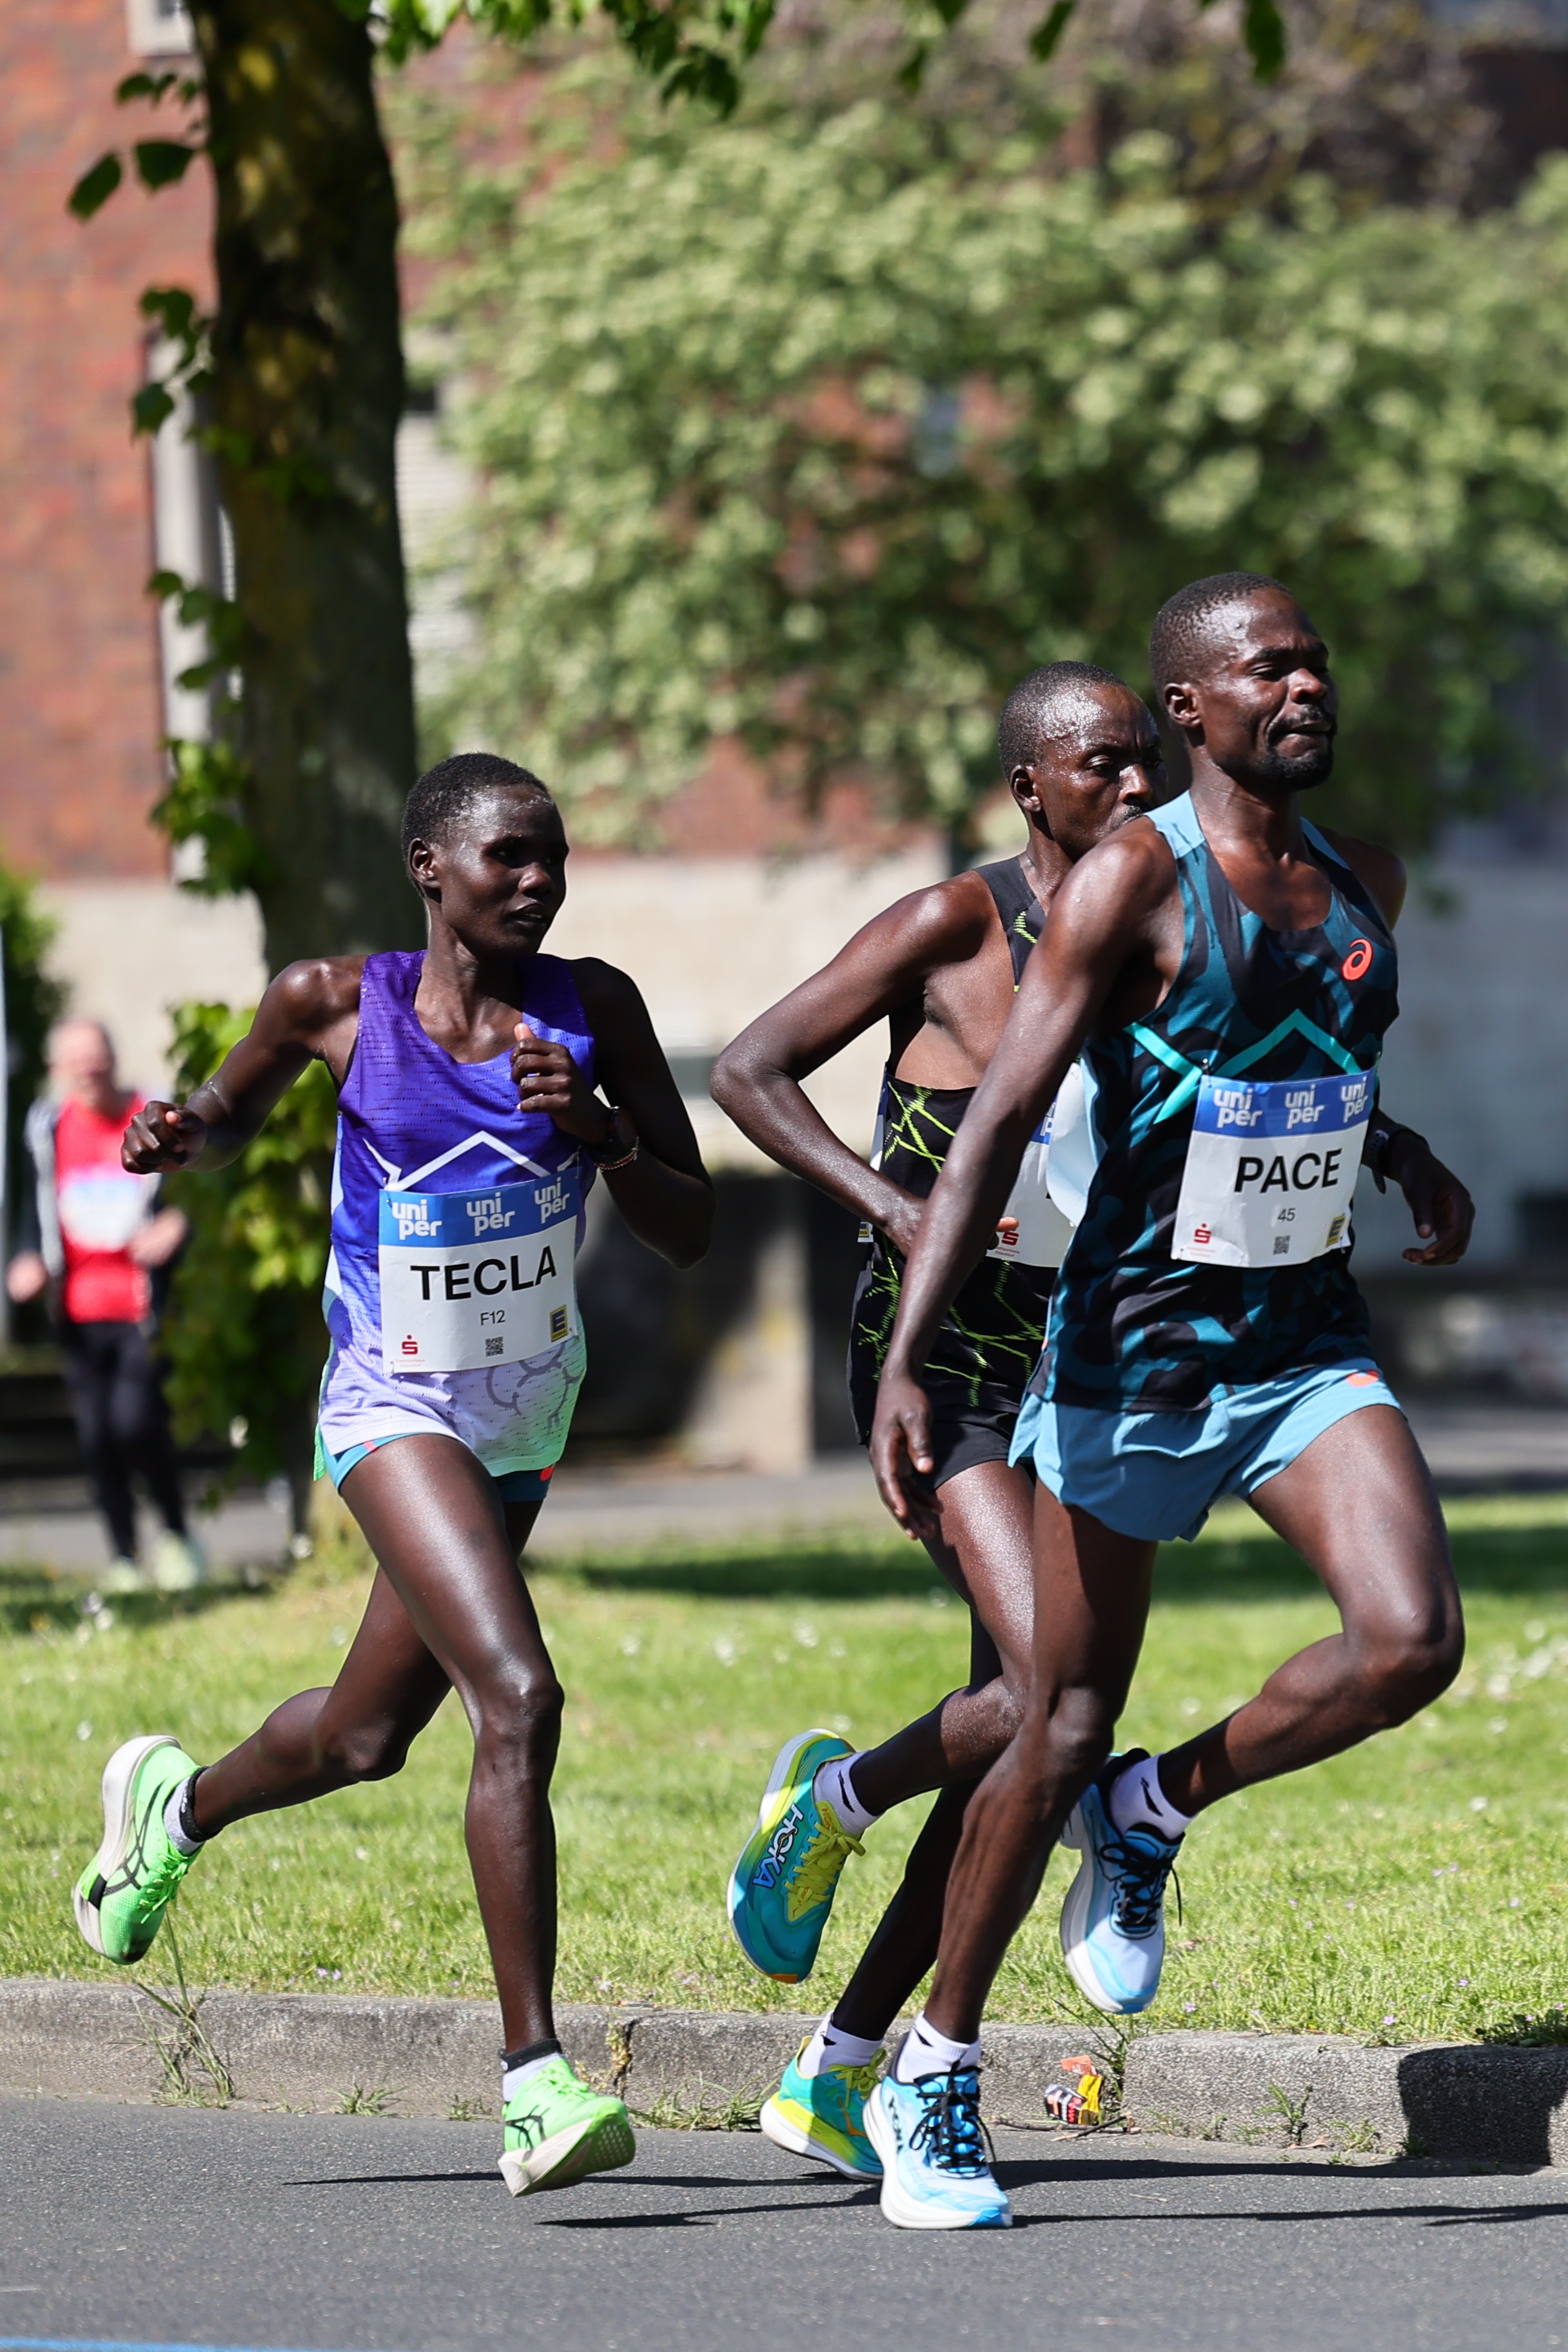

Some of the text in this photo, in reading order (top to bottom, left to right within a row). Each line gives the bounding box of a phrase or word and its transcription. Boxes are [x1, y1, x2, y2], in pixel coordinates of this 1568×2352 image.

[1213, 1087, 1253, 1110] uni
[1285, 1084, 1316, 1108] uni
[1340, 1076, 1367, 1102] uni
[1217, 1108, 1264, 1128] per
[1286, 1105, 1325, 1129] per
[1343, 1095, 1369, 1123] per
[1234, 1148, 1343, 1193] PACE
[466, 1191, 502, 1217] uni
[534, 1177, 562, 1205] uni
[392, 1199, 428, 1220] uni
[540, 1193, 571, 1224] per
[1277, 1208, 1297, 1222] 45
[399, 1219, 442, 1240] per
[474, 1211, 516, 1237] per
[410, 1245, 557, 1300] TECLA
[480, 1309, 506, 1326] F12
[752, 1803, 805, 1888] HOKA
